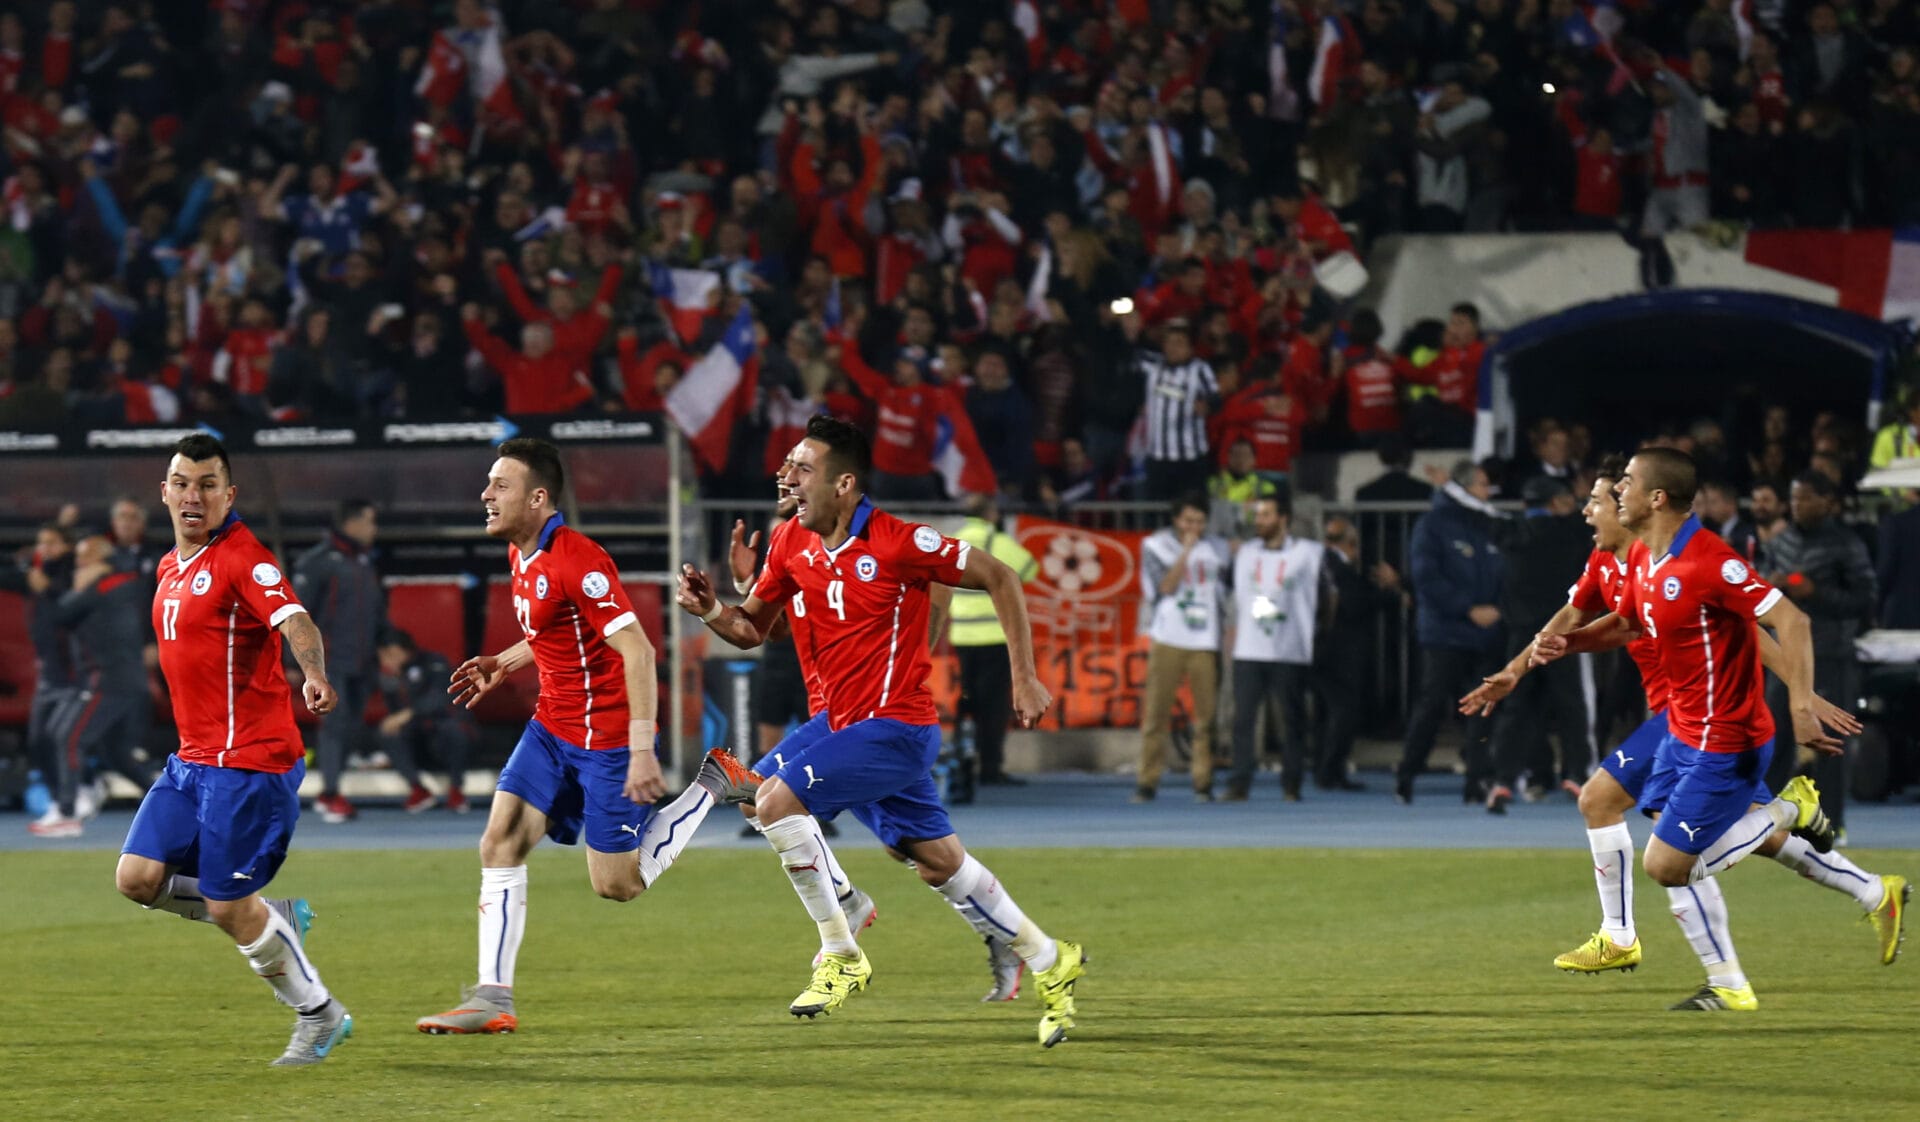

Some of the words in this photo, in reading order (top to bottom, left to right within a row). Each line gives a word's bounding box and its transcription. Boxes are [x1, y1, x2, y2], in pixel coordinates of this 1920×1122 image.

[87, 428, 208, 449] POWERA
[162, 598, 181, 640] 17
[826, 580, 847, 621] 4
[1643, 602, 1658, 638] 5
